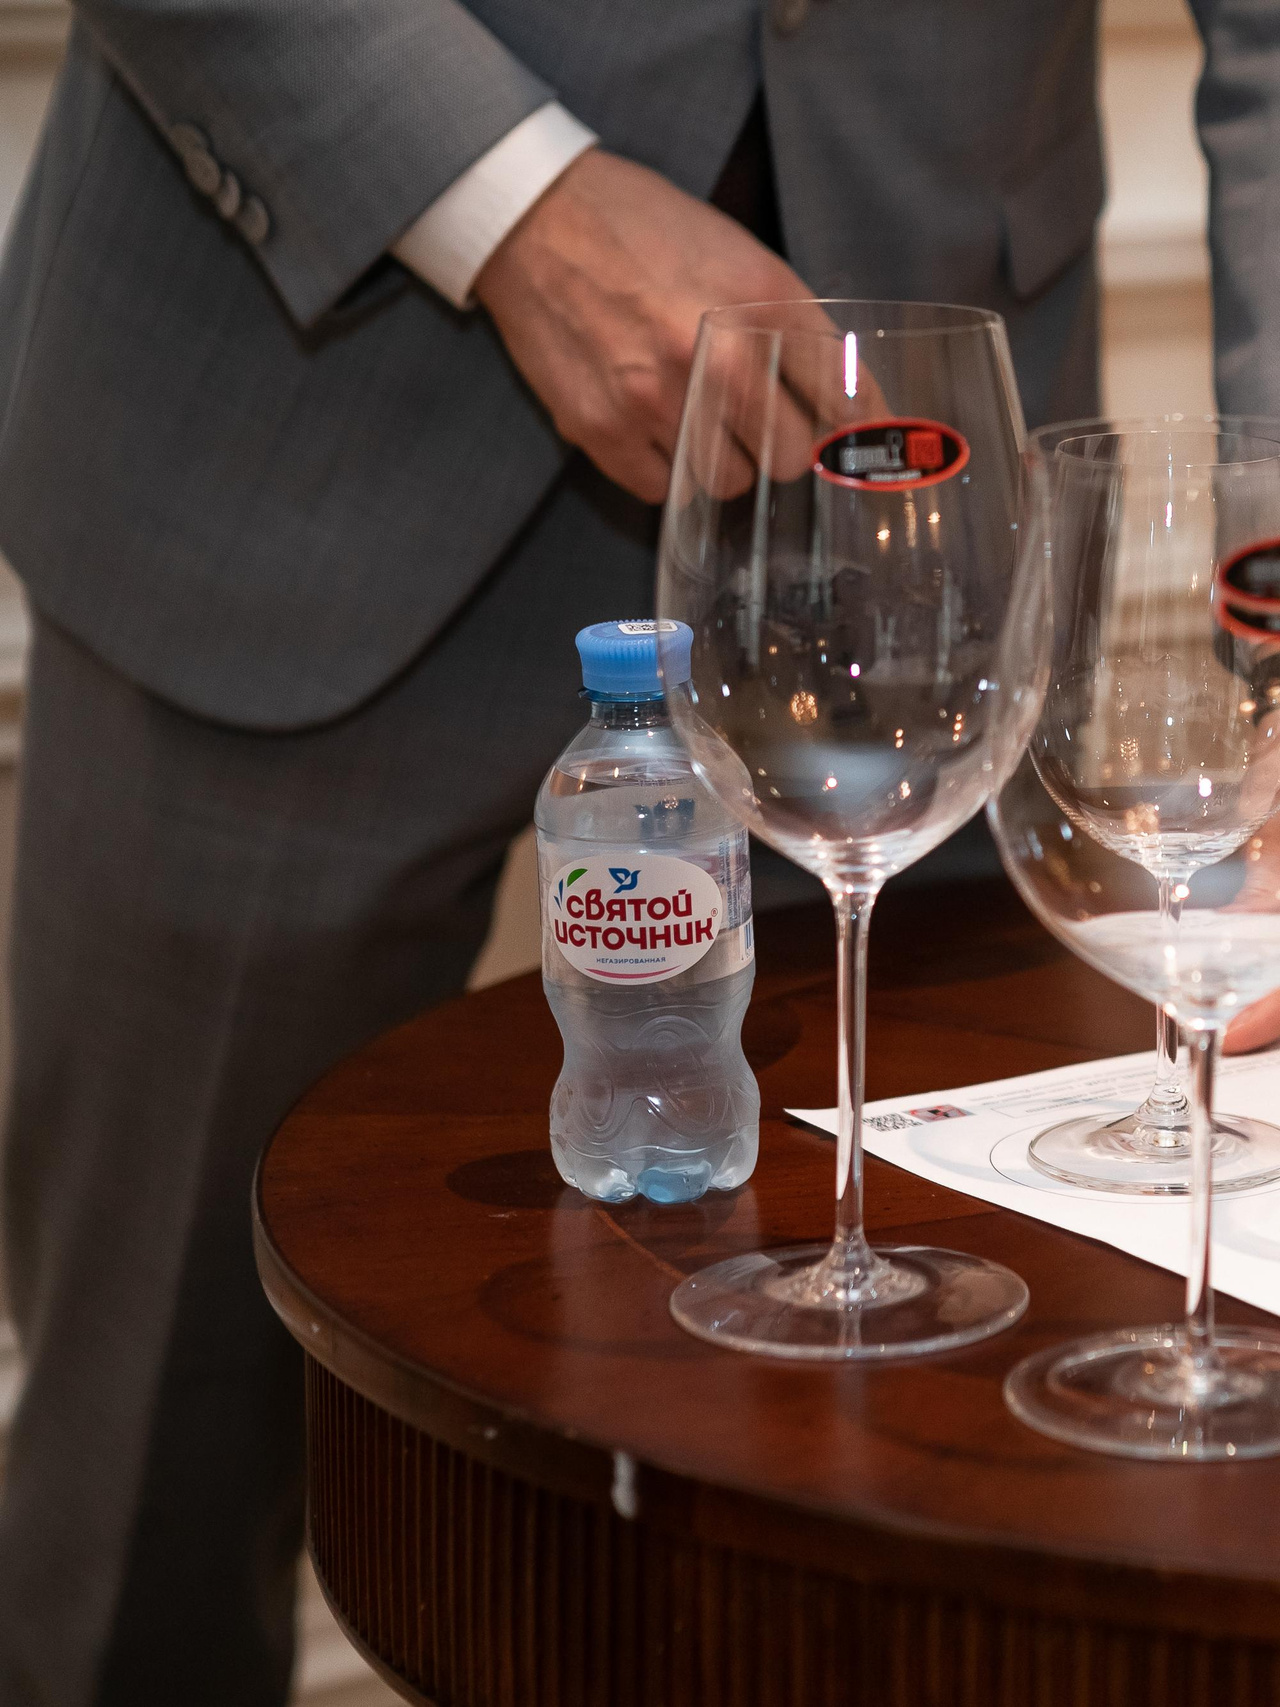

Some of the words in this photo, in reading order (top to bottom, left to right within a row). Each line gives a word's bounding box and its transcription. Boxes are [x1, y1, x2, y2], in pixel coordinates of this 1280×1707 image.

[566, 888, 693, 922] СВЯТОЙ
[553, 917, 714, 951] ИСТОЧНИК
[596, 957, 667, 965] НЕГАЗИРОВАННАЯ
